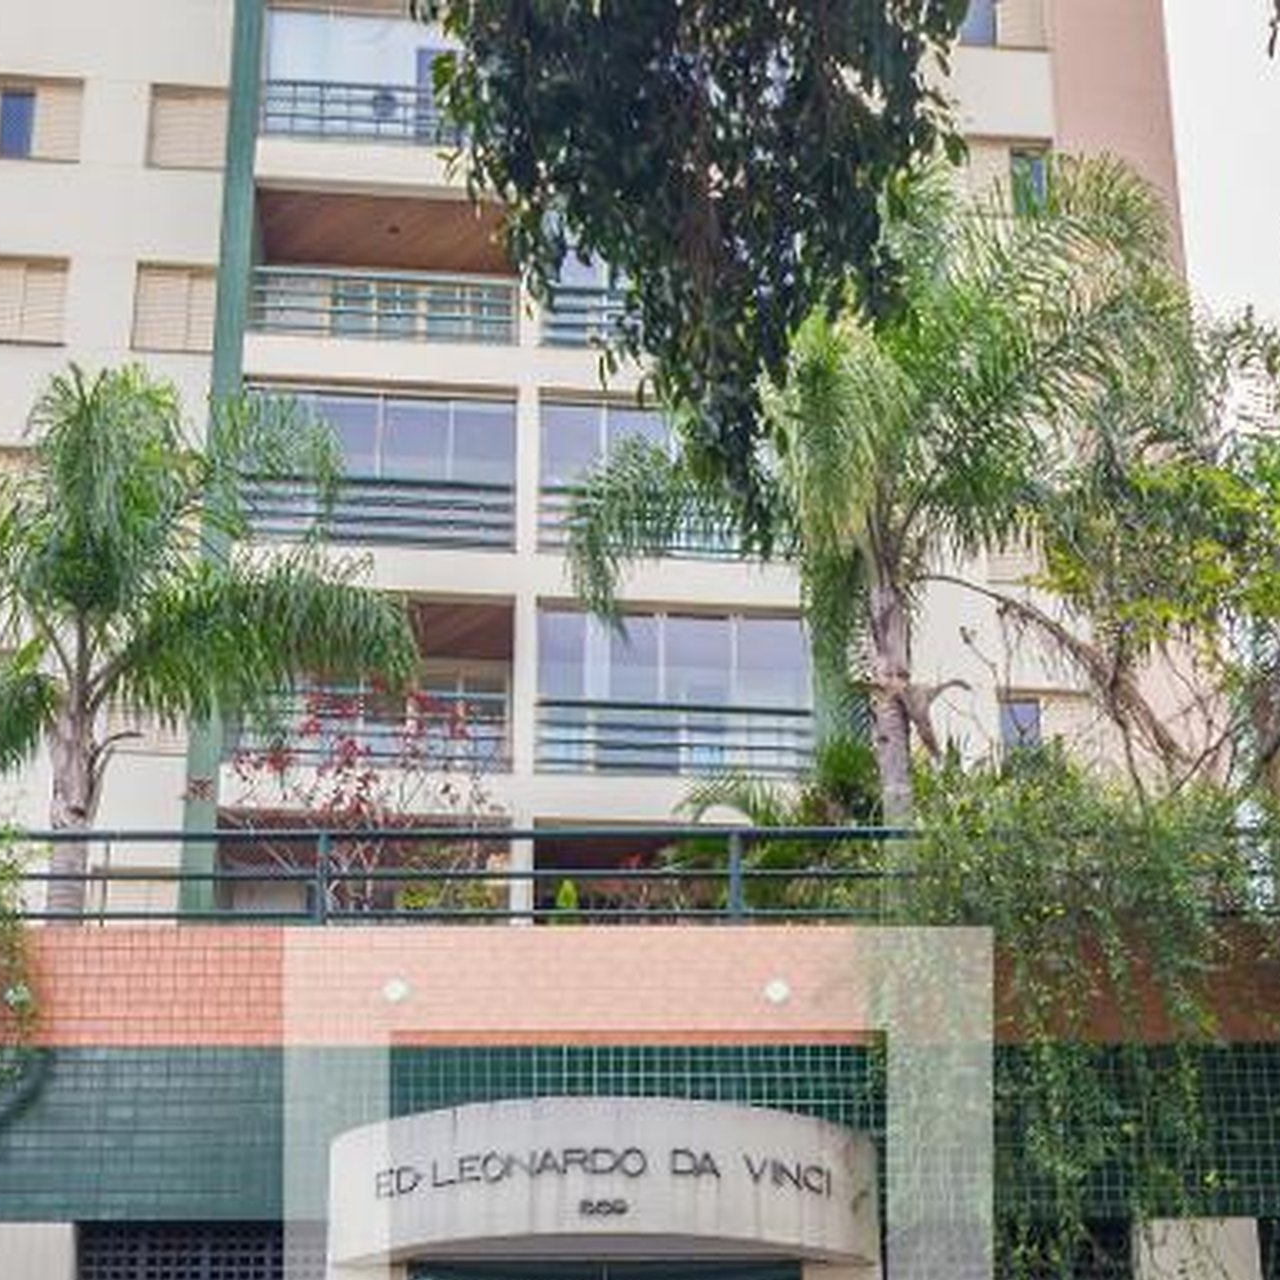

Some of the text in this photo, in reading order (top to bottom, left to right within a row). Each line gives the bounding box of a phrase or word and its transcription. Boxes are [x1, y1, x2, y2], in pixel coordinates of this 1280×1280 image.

[432, 1147, 648, 1188] LEONARDO
[671, 1148, 721, 1179] DA
[743, 1153, 832, 1200] VINCI
